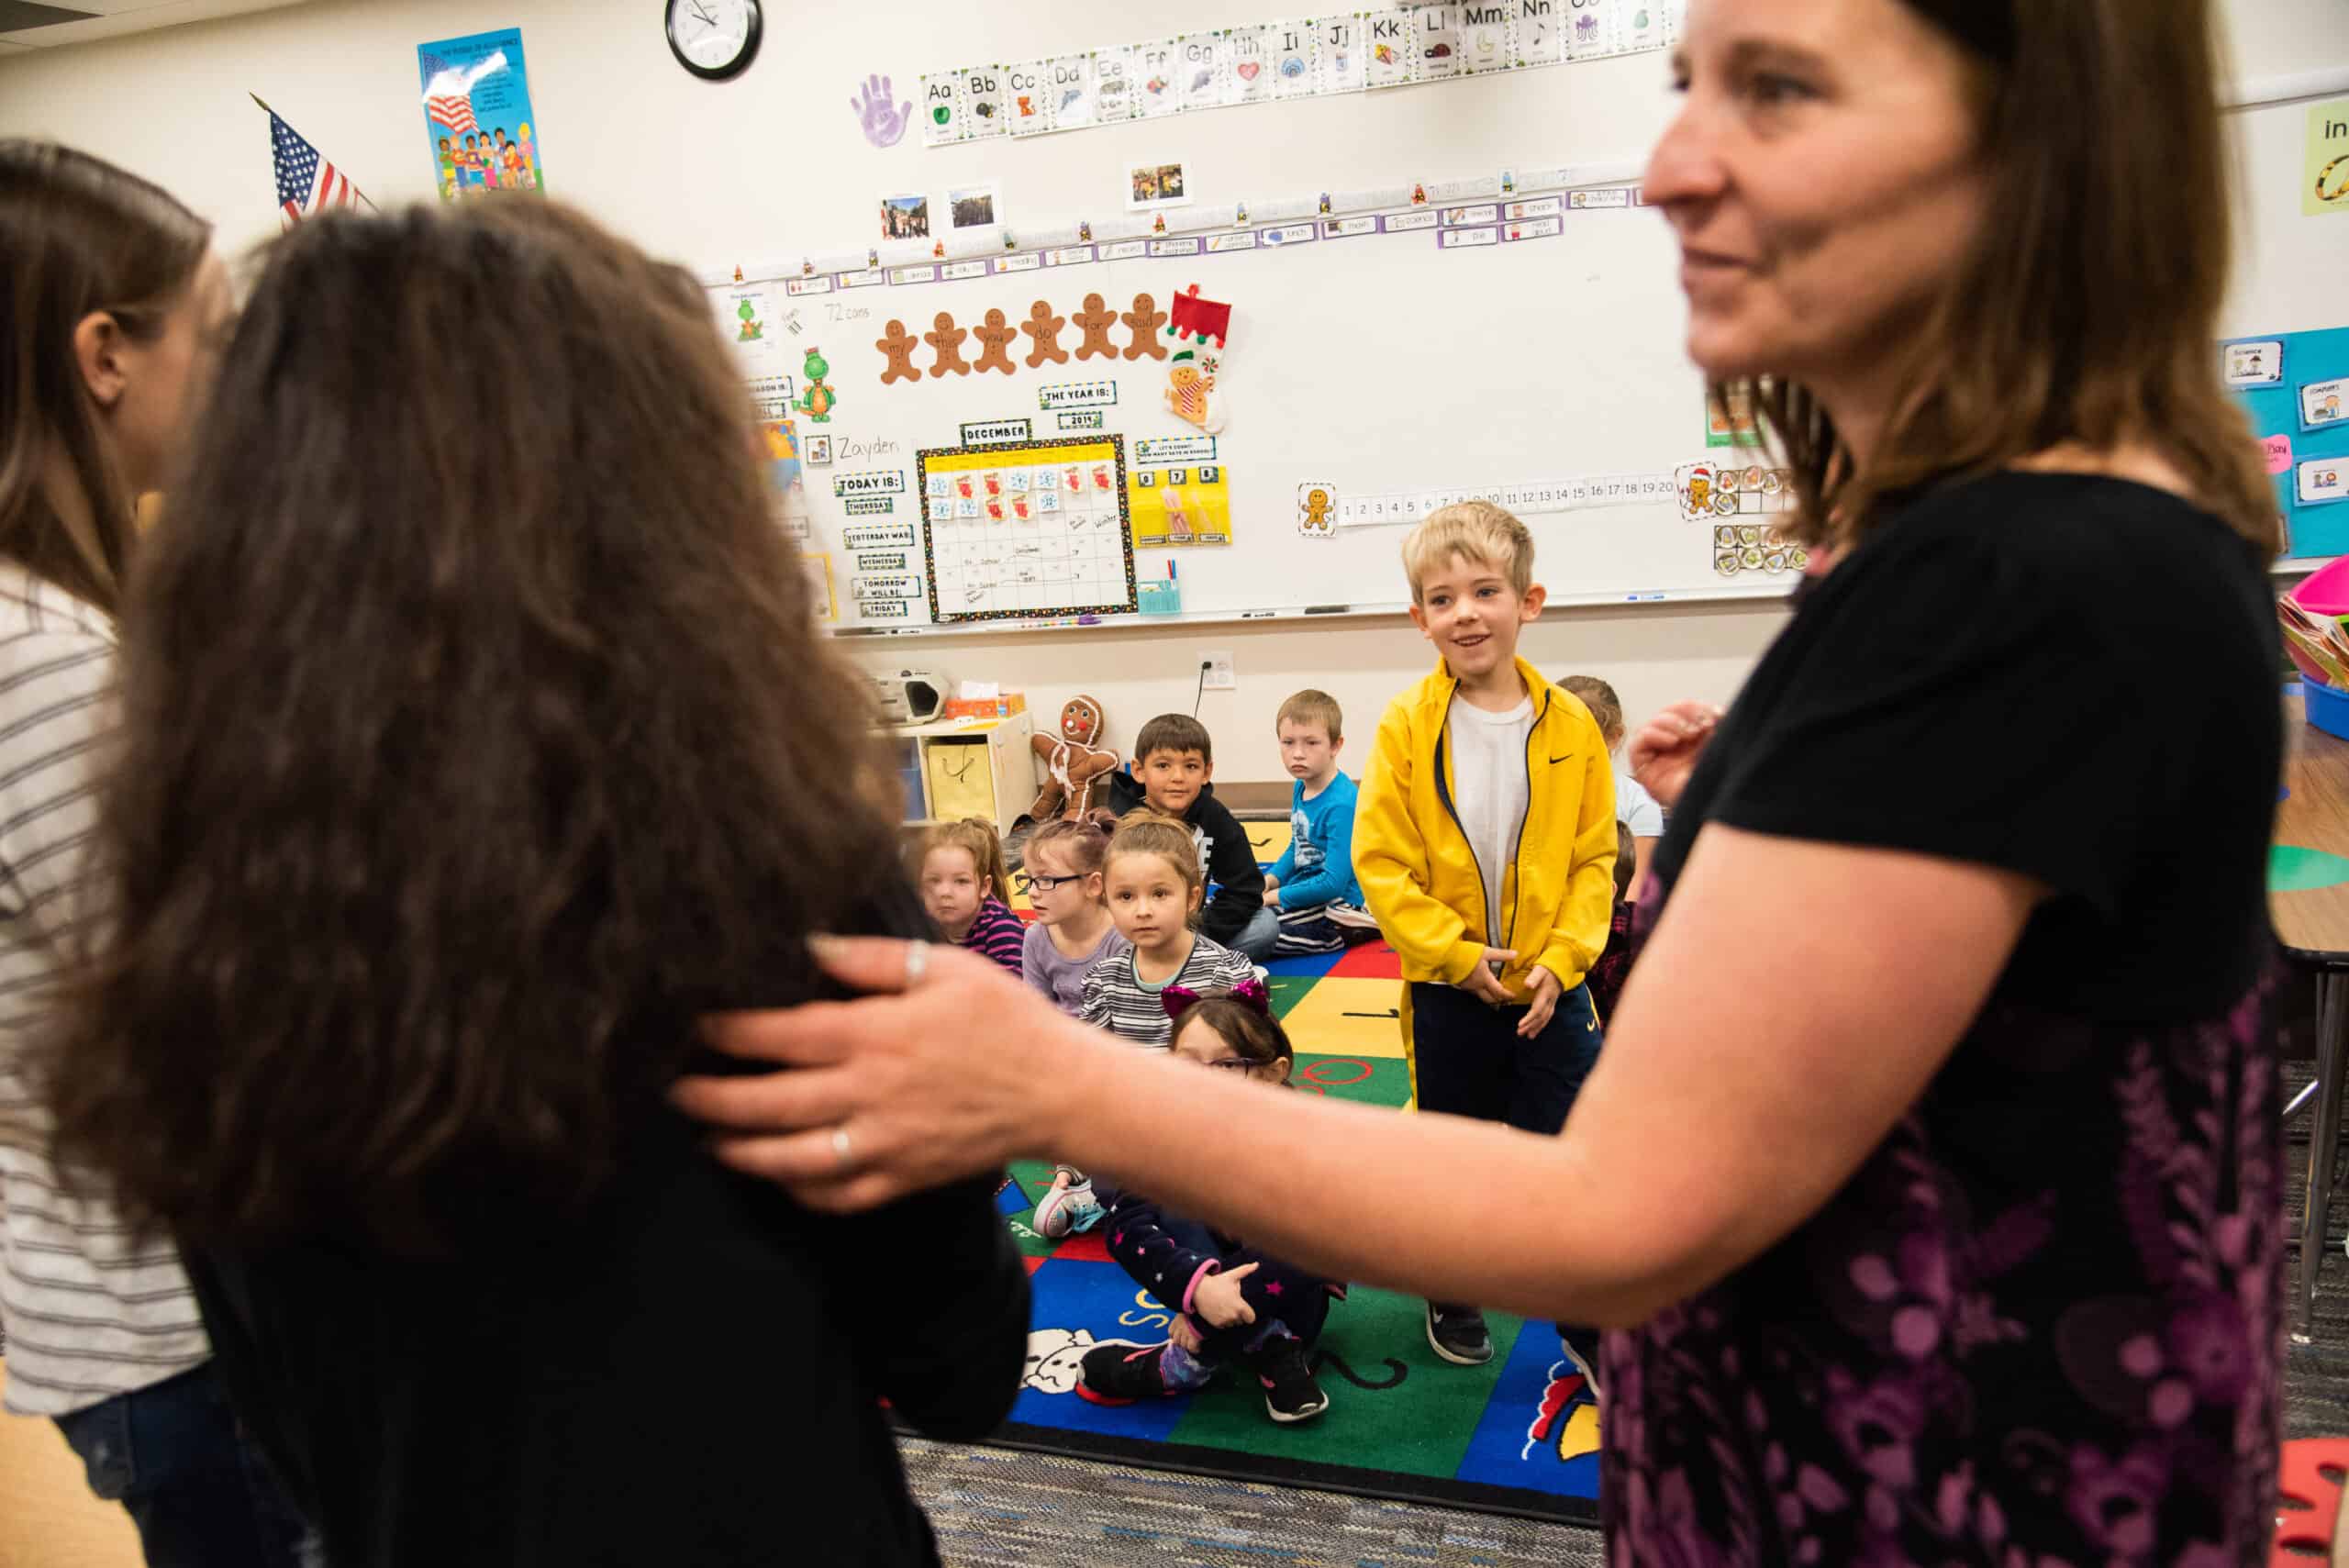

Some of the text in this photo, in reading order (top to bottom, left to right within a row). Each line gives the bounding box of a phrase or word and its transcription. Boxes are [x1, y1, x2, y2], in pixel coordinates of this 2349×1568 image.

[928, 83, 951, 101] Aa
[971, 76, 996, 95] Bb
[1011, 73, 1036, 90] Cc
[1055, 67, 1081, 84] Dd
[1099, 60, 1123, 77] Ee
[1146, 51, 1167, 68] Ff
[1186, 44, 1213, 64] Gg
[1284, 31, 1299, 51] Ii
[1329, 26, 1349, 50] Jj
[1374, 19, 1400, 39] Kk
[1426, 13, 1445, 32] Ll
[1466, 6, 1503, 25] Mm
[1523, 0, 1550, 17] Nn
[1035, 323, 1052, 339] do
[1046, 389, 1064, 401] THE
[1068, 386, 1094, 399] YEAR
[1072, 416, 1093, 425] 2019
[967, 426, 1025, 439] DECEMBER
[841, 477, 878, 491] TODAY
[1345, 506, 1350, 516] 1
[1360, 504, 1366, 515] 2
[1375, 503, 1382, 514] 3
[1392, 502, 1398, 512] 4
[1408, 501, 1415, 512] 5
[1508, 493, 1517, 504] 11
[1522, 492, 1535, 503] 12
[1540, 491, 1552, 501] 13
[1556, 489, 1568, 500] 14
[1573, 488, 1586, 499] 15
[1591, 485, 1603, 496] 16
[1609, 484, 1620, 495] 17
[1625, 484, 1638, 495] 18
[1642, 483, 1655, 493] 19
[1658, 482, 1674, 493] 20
[863, 580, 907, 588] TOMORROW
